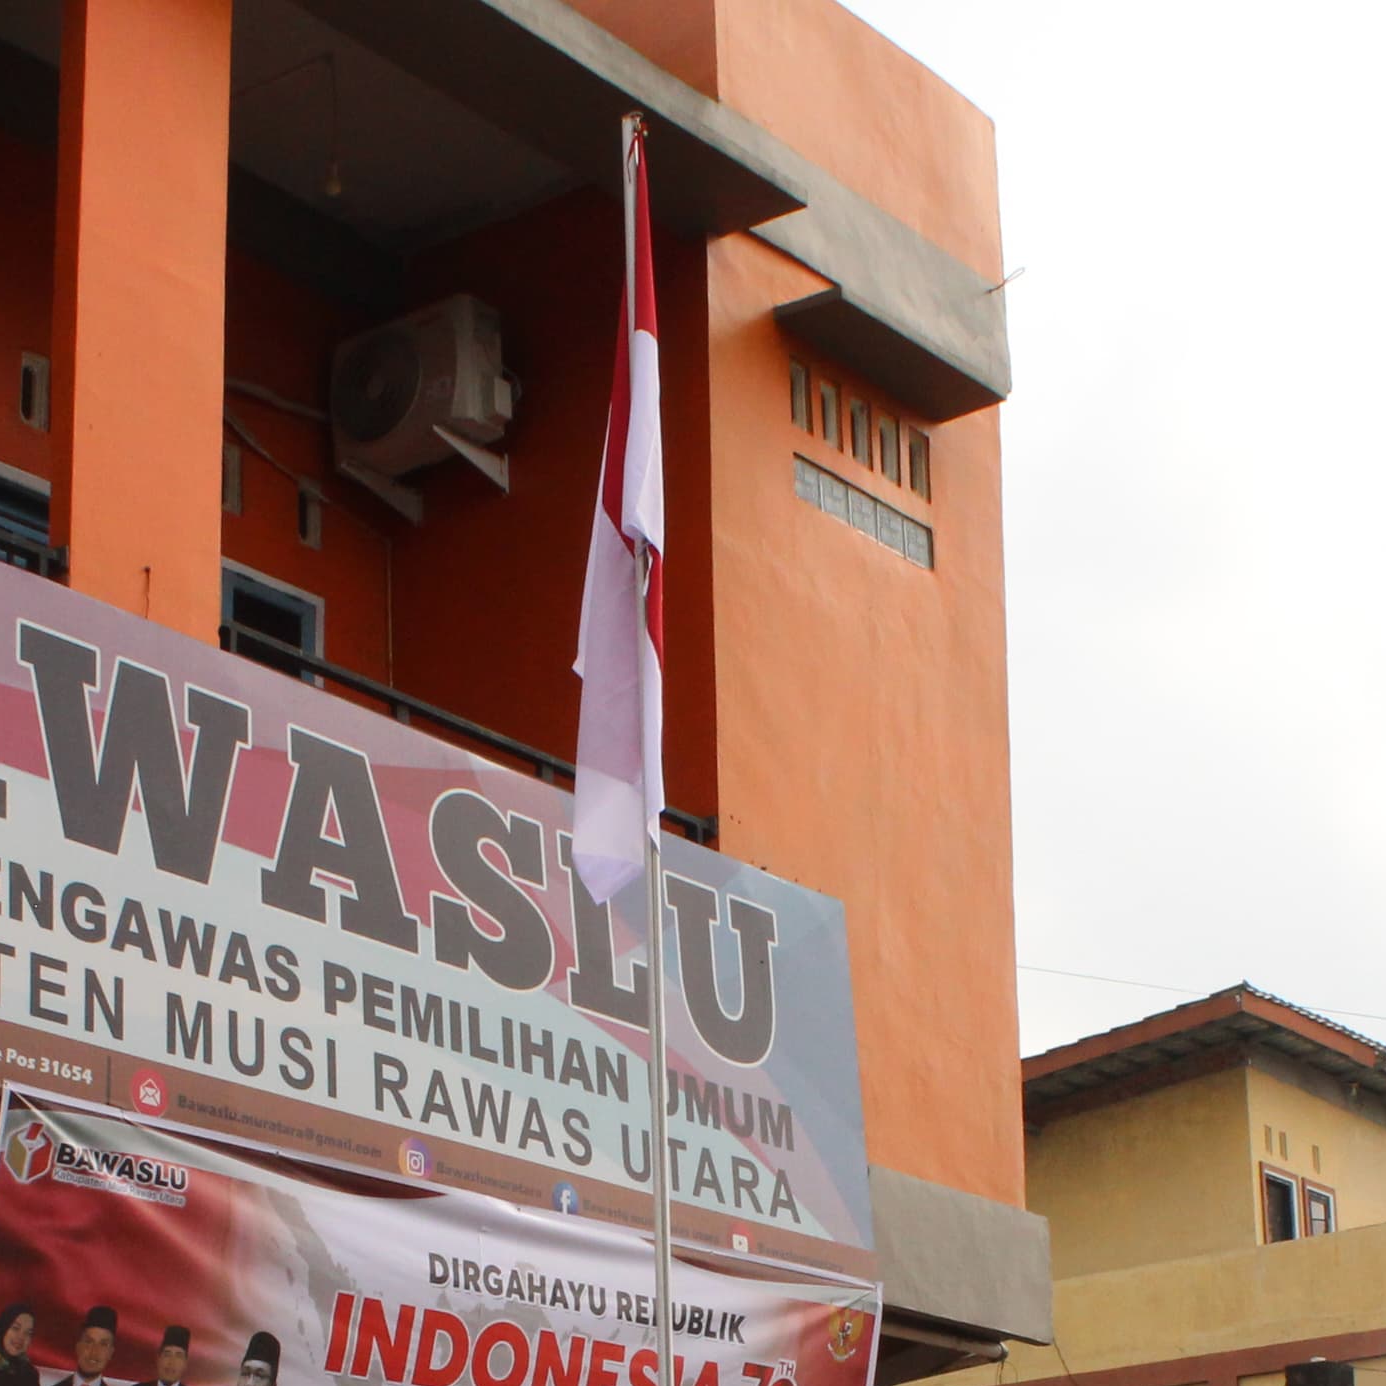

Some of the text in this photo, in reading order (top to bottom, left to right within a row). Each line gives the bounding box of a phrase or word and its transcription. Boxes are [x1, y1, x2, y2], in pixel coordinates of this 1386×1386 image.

[322, 960, 630, 1104] PEMILIHAN
[5, 1047, 37, 1071] Pos
[39, 1052, 93, 1085] 31654
[165, 991, 338, 1099] MUSI
[374, 1050, 594, 1168] RAWAS
[621, 1123, 802, 1225] UTARA
[56, 1142, 187, 1191] BAWASLU
[428, 1253, 609, 1316] DIRGAHAYU
